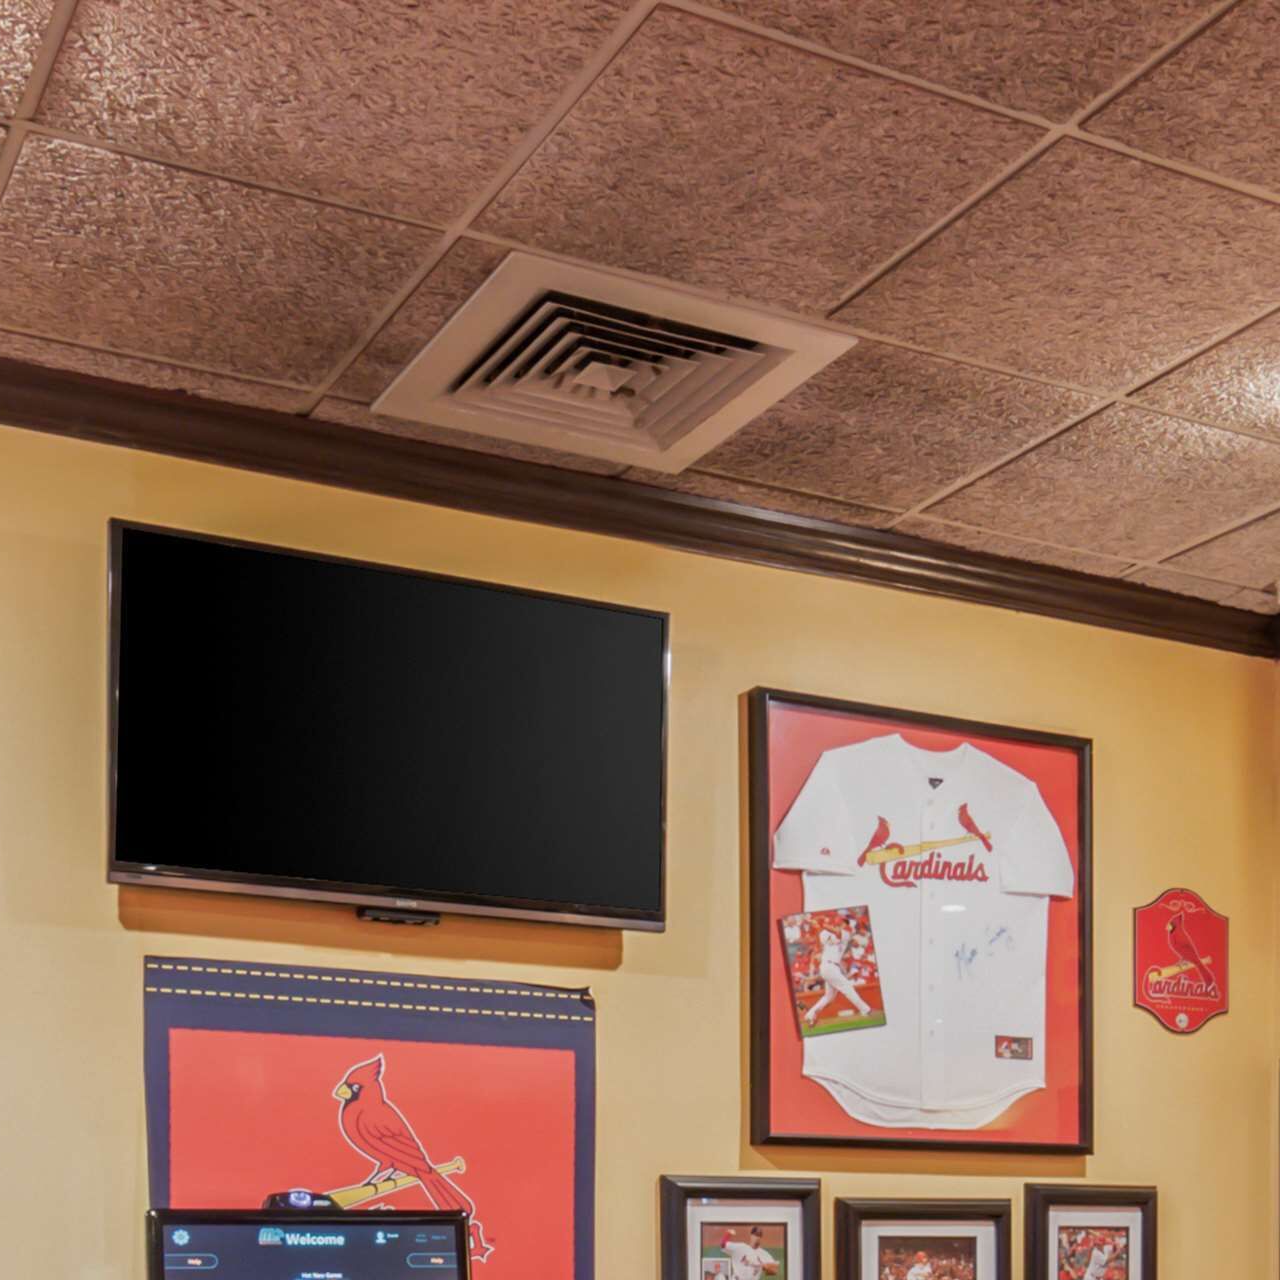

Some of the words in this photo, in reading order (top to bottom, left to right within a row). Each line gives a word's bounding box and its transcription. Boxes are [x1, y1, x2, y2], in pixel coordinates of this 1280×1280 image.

[879, 842, 989, 888] Cardinals
[1143, 966, 1220, 1004] Cardinals
[285, 1233, 345, 1246] Welcome
